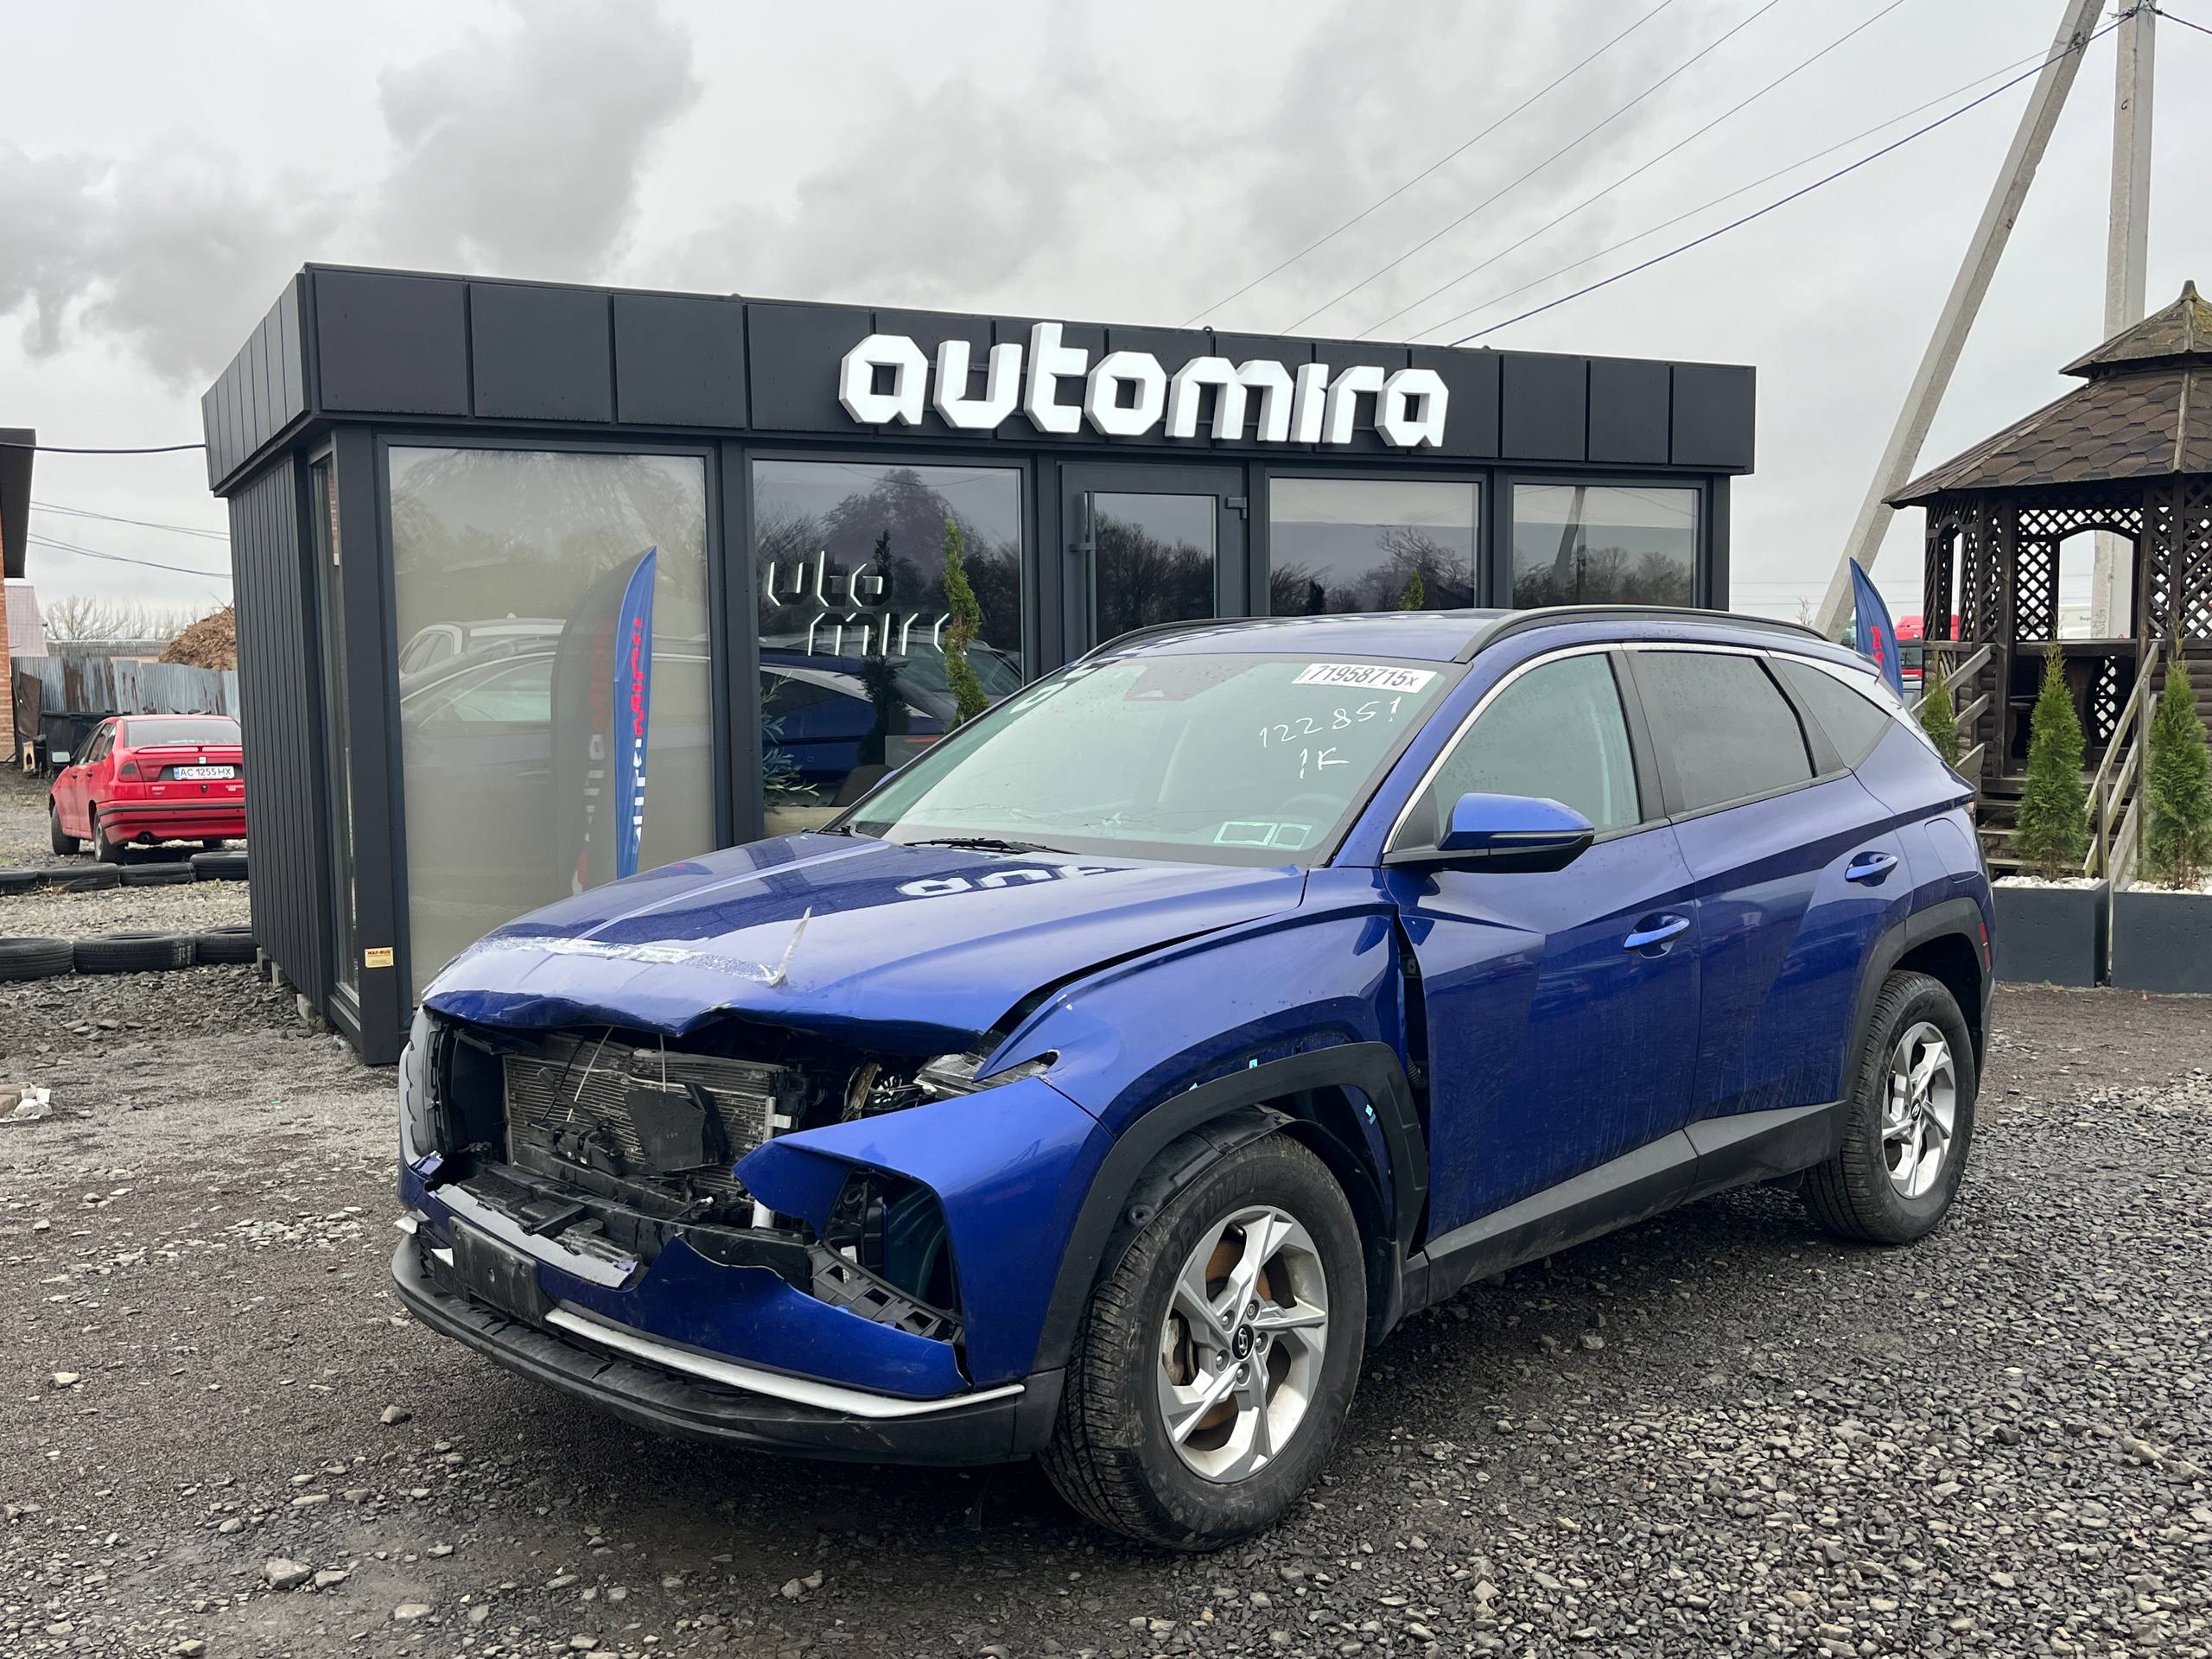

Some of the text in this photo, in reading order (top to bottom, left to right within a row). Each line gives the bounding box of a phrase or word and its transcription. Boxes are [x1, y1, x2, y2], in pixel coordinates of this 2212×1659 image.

[838, 322, 1450, 448] automira
[181, 766, 232, 777] AC 1255 HX
